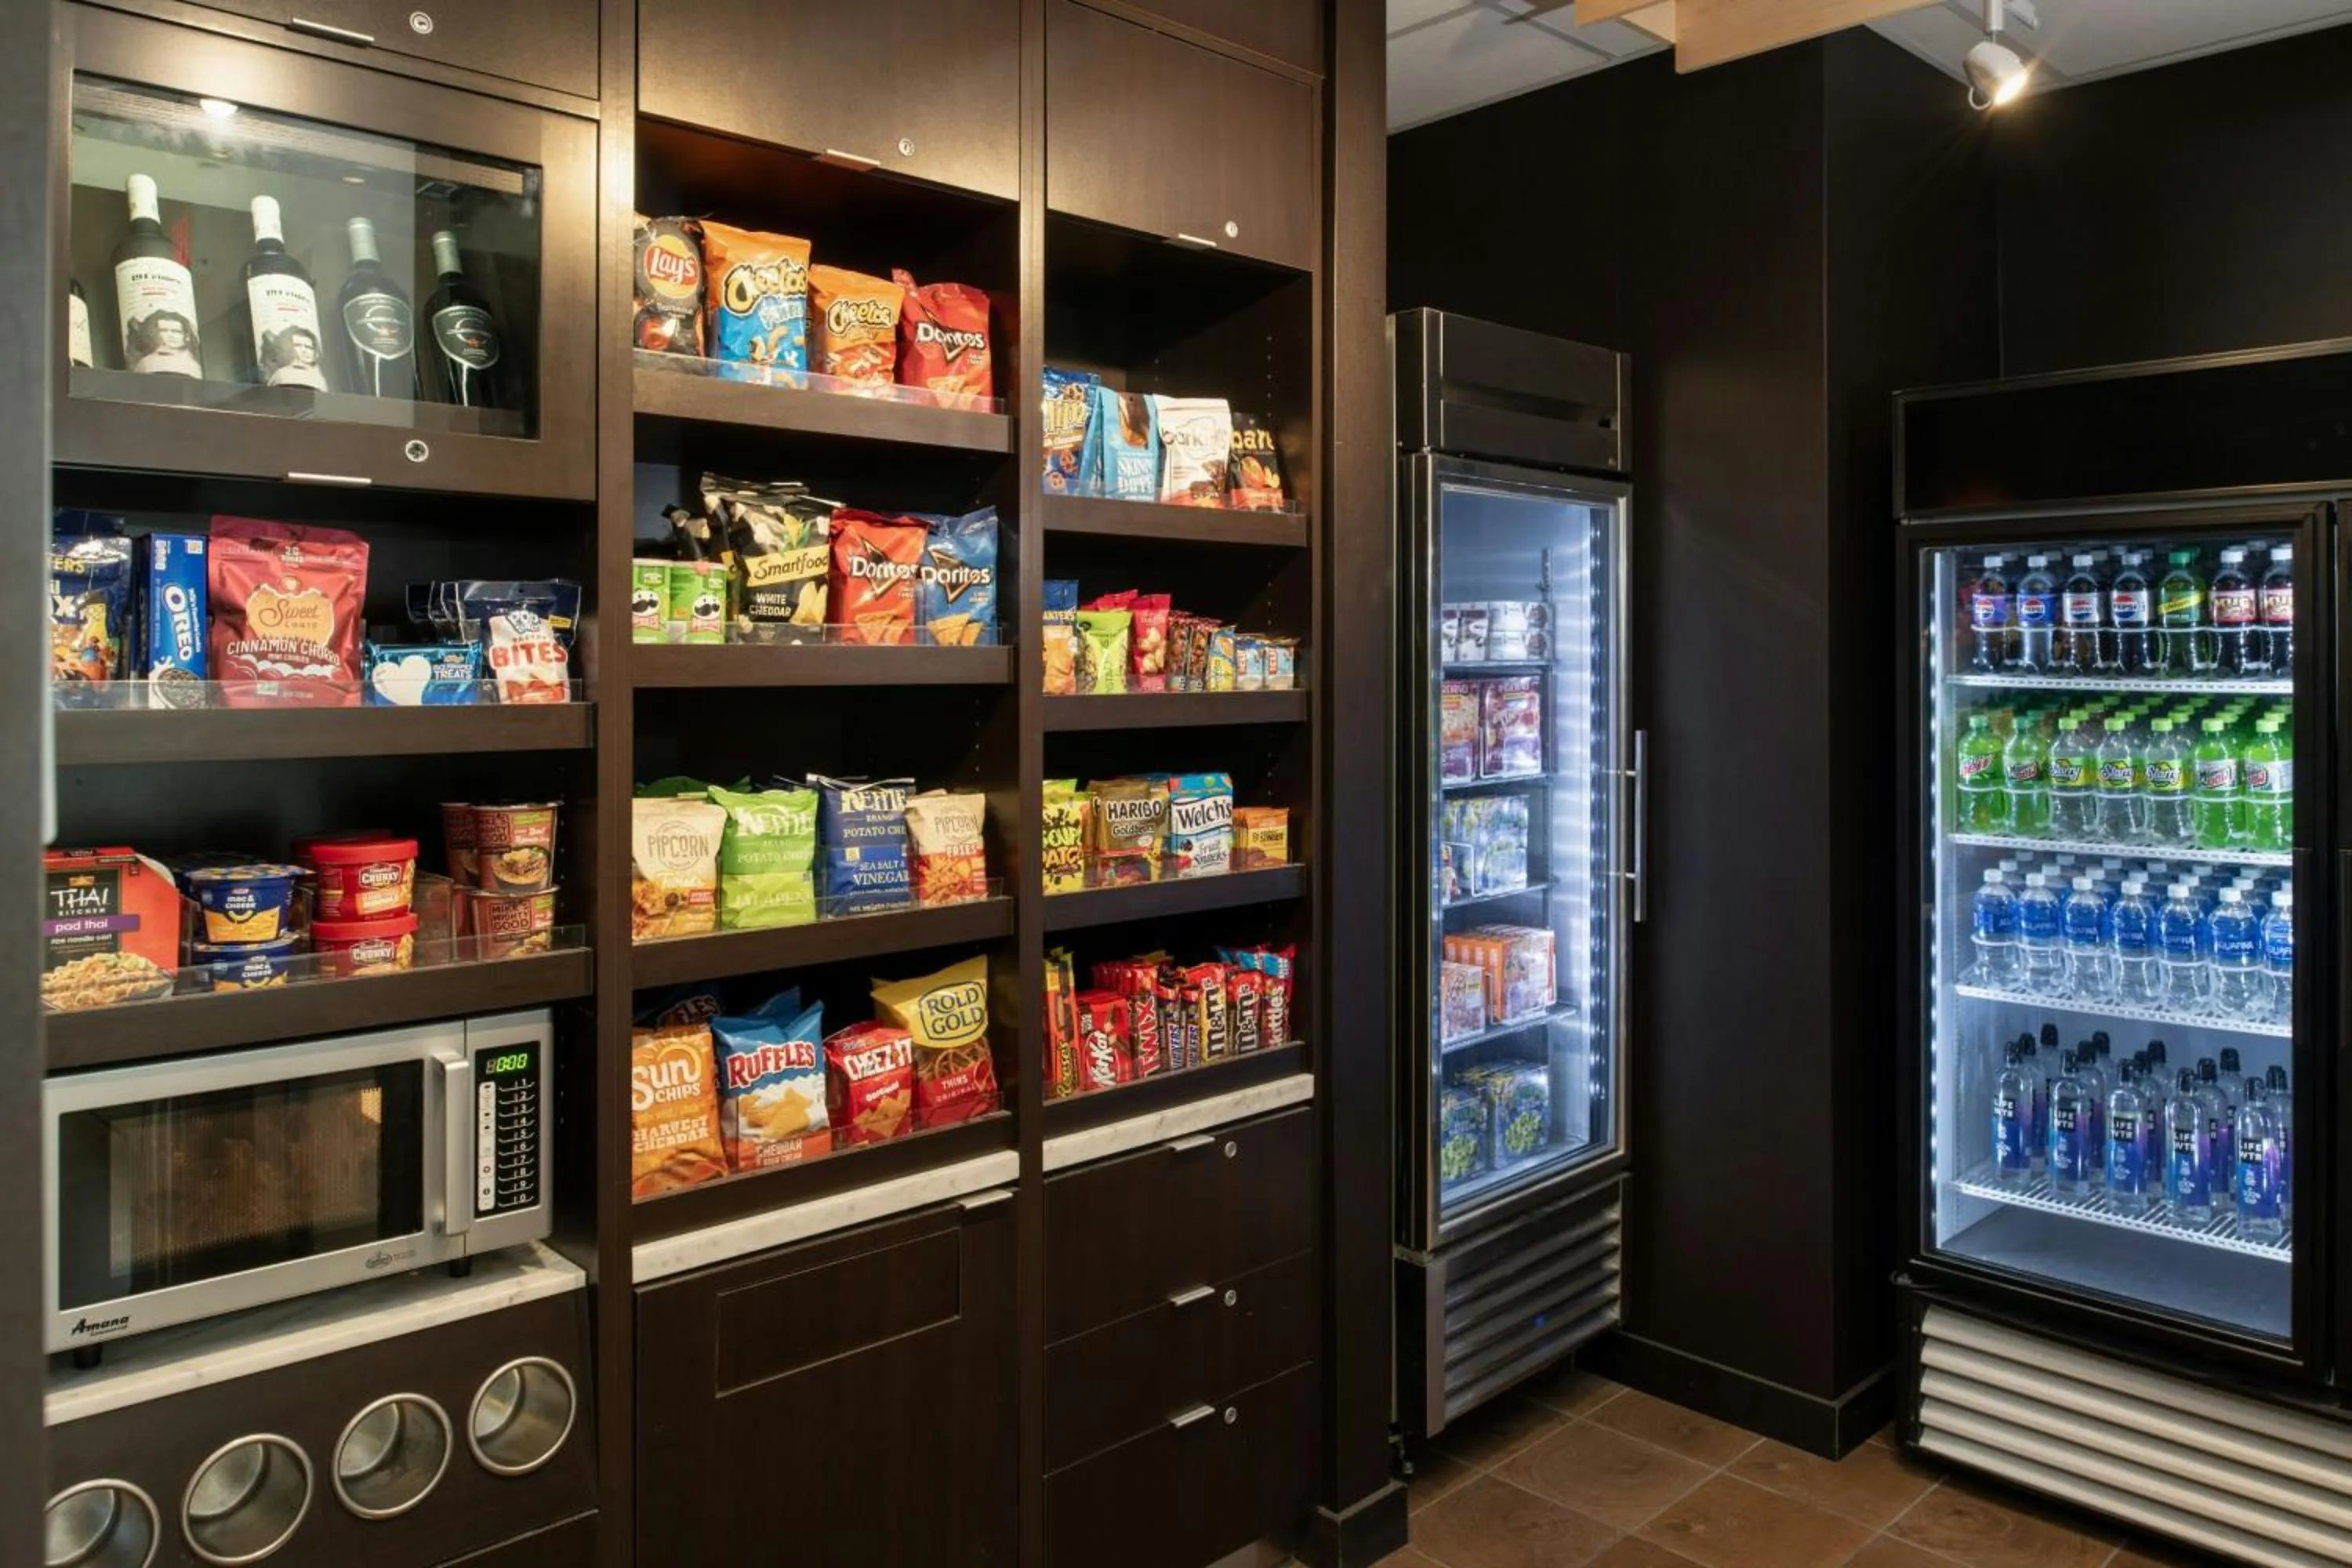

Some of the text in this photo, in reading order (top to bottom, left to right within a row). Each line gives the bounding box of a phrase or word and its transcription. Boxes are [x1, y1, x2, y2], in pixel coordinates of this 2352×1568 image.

[828, 299, 892, 334] Cheetos
[916, 321, 985, 350] Doritos
[851, 556, 918, 580] Doritos
[920, 565, 991, 585] Doritos
[755, 592, 786, 604] WHITE
[259, 598, 320, 627] Sweet
[749, 603, 792, 618] CHEDDAR
[1043, 610, 1076, 621] ANTERS
[164, 586, 193, 661] OREO
[227, 638, 340, 666] CINNAMON CHURRO
[434, 670, 472, 680] TREATS
[1107, 800, 1161, 821] HARIBO
[1178, 800, 1232, 829] Welch's
[843, 825, 905, 838] POTATO CHI
[934, 815, 978, 835] PIPCORN
[648, 834, 710, 858] PIPCORN
[946, 843, 978, 857] FRIES
[737, 853, 781, 862] POTATO
[859, 861, 876, 871] SEA
[877, 859, 897, 869] SALT
[50, 887, 109, 909] THAI
[56, 918, 108, 934] pad thai
[493, 919, 529, 931] GOOD
[926, 986, 979, 1017] ROLD
[931, 1006, 985, 1035] GOLD
[1269, 985, 1285, 1047] kittles
[1137, 995, 1161, 1079] TWIX
[728, 1041, 815, 1089] RUFFLES
[632, 1058, 694, 1111] Sun
[942, 1074, 969, 1090] THINS
[654, 1083, 702, 1103] CHIPS
[2111, 1129, 2134, 1138] WTR
[2112, 1120, 2134, 1130] LIFE
[2173, 1132, 2196, 1142] LIFE
[2240, 1142, 2262, 1152] LIFE
[2240, 1151, 2263, 1161] WTR
[71, 1315, 130, 1335] Amana
